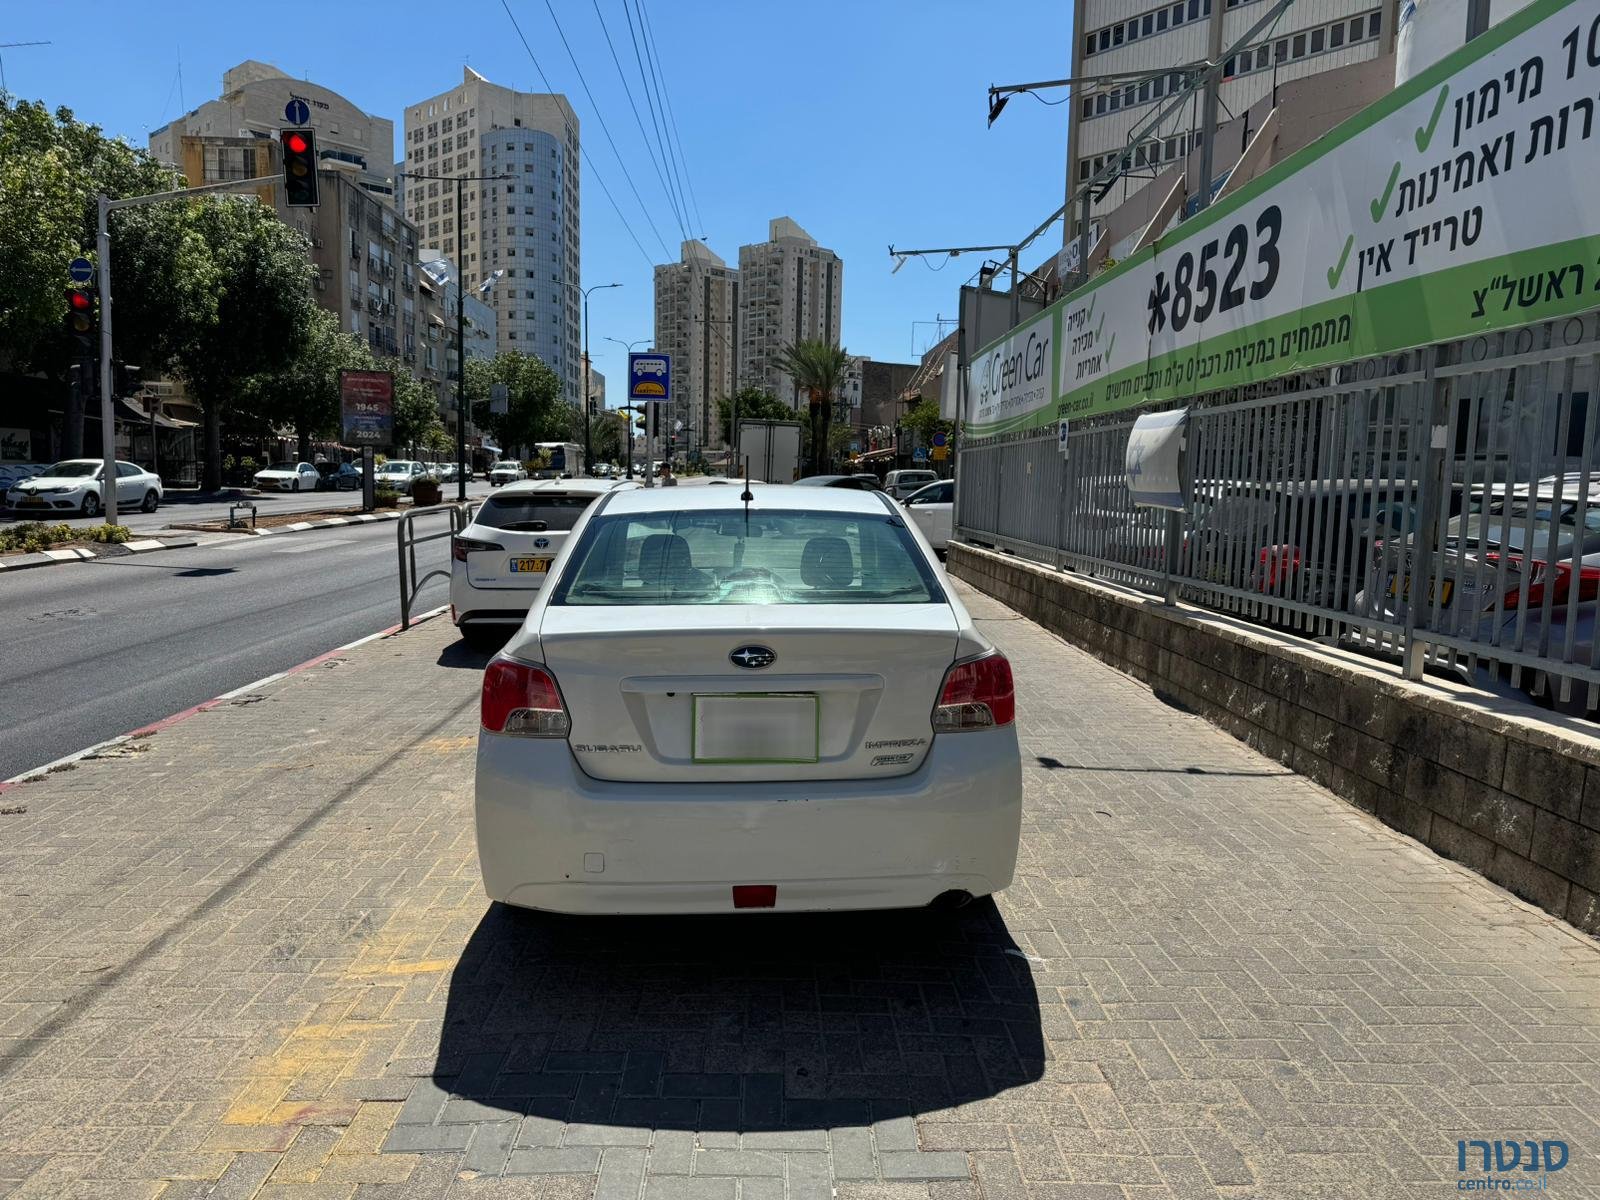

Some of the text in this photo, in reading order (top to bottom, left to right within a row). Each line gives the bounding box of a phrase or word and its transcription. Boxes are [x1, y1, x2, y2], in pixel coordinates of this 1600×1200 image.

[1452, 56, 1543, 148] מימון
[1395, 91, 1600, 218] רות ואמינות
[1356, 205, 1483, 293] טרייד אין
[1067, 307, 1086, 332] קנייה
[1071, 330, 1093, 355] מכירה
[1280, 314, 1350, 357] מתמחים
[992, 331, 1049, 396] Green Car
[1076, 353, 1102, 380] אחריות
[1185, 357, 1194, 381] 0
[1195, 354, 1221, 381] רכבי
[1223, 340, 1276, 374] במכירת
[1106, 378, 1132, 402] חדשים
[356, 402, 379, 411] 1945
[356, 430, 381, 439] 2024
[575, 744, 642, 753] SUBARU
